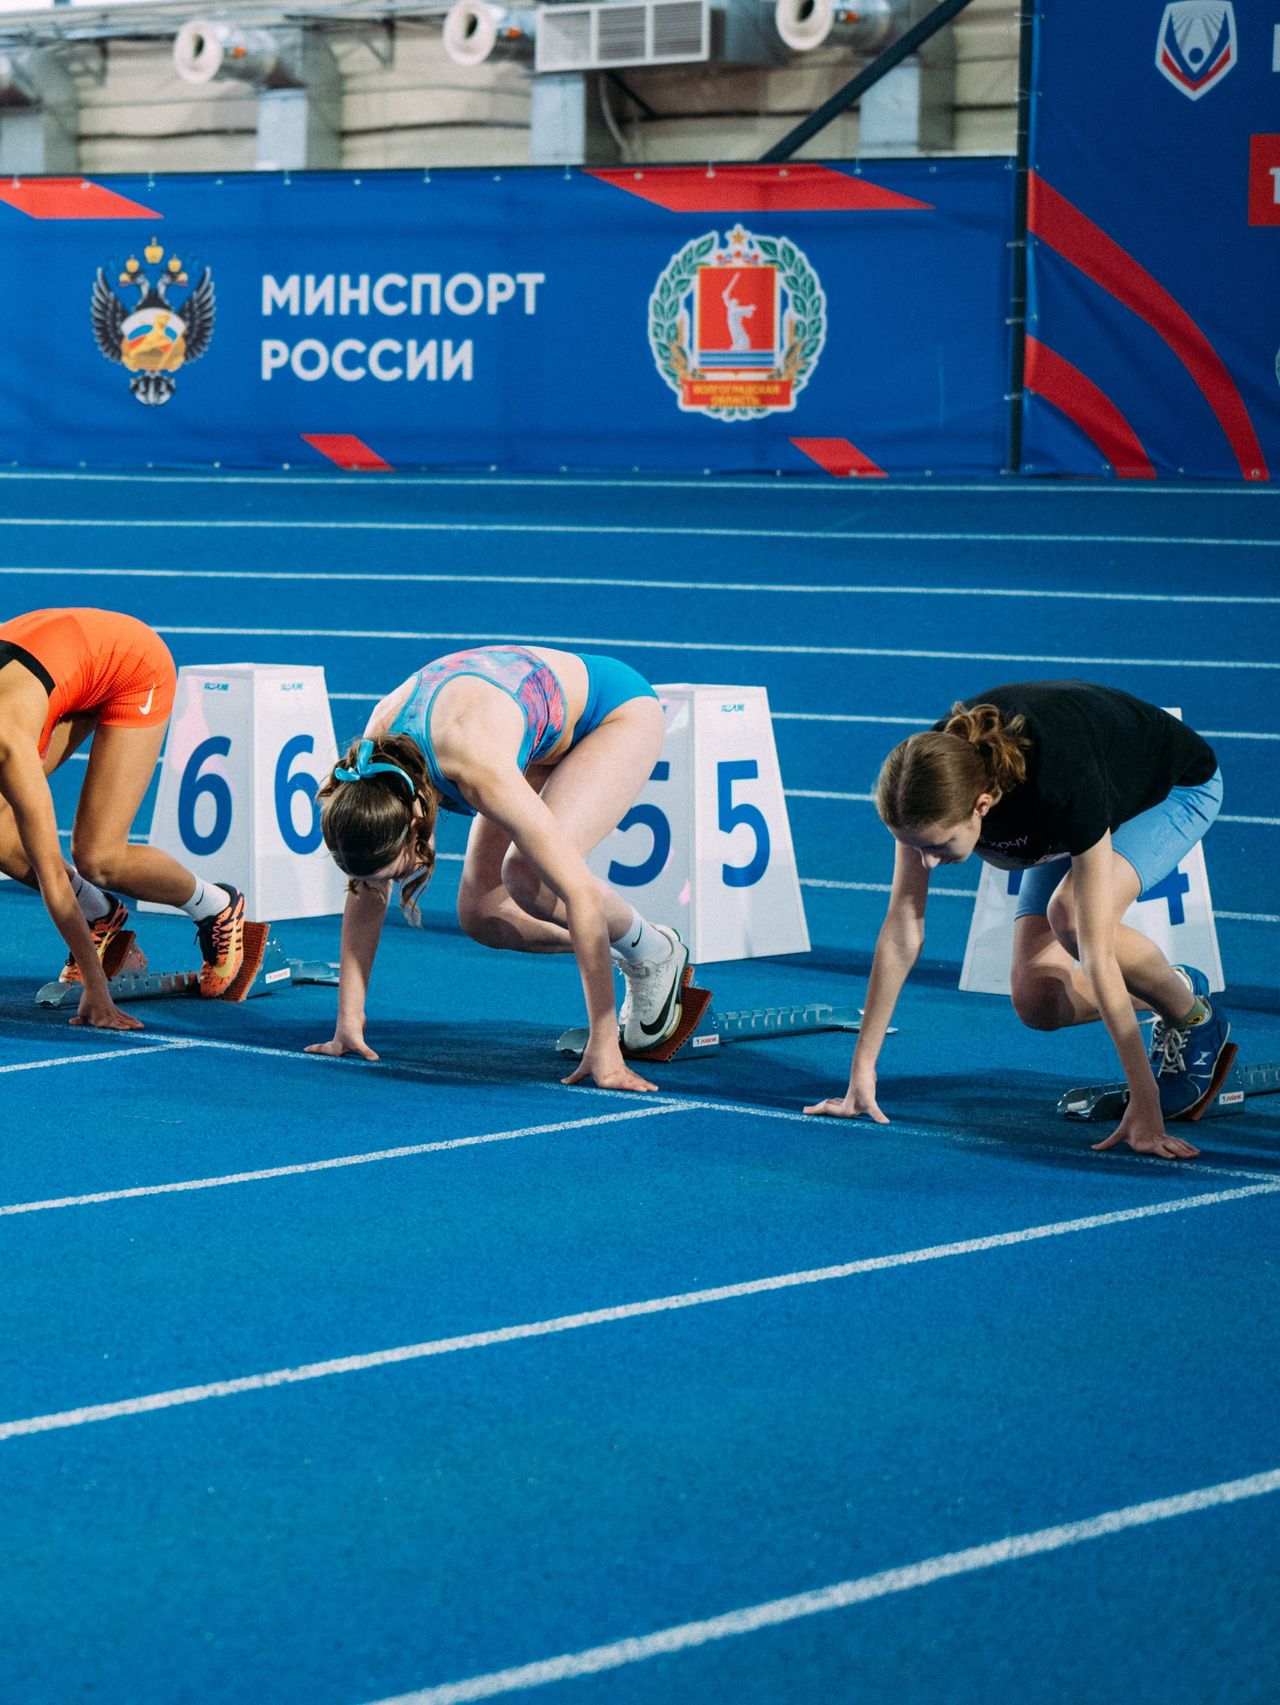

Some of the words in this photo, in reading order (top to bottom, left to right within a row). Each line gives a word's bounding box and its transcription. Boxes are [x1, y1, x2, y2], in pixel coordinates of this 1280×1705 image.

[262, 273, 545, 316] МИНСПОРТ
[262, 339, 473, 381] РОССИИ
[178, 736, 232, 856] 6
[274, 734, 324, 855] 6
[607, 761, 671, 887] 5
[717, 759, 770, 888] 5
